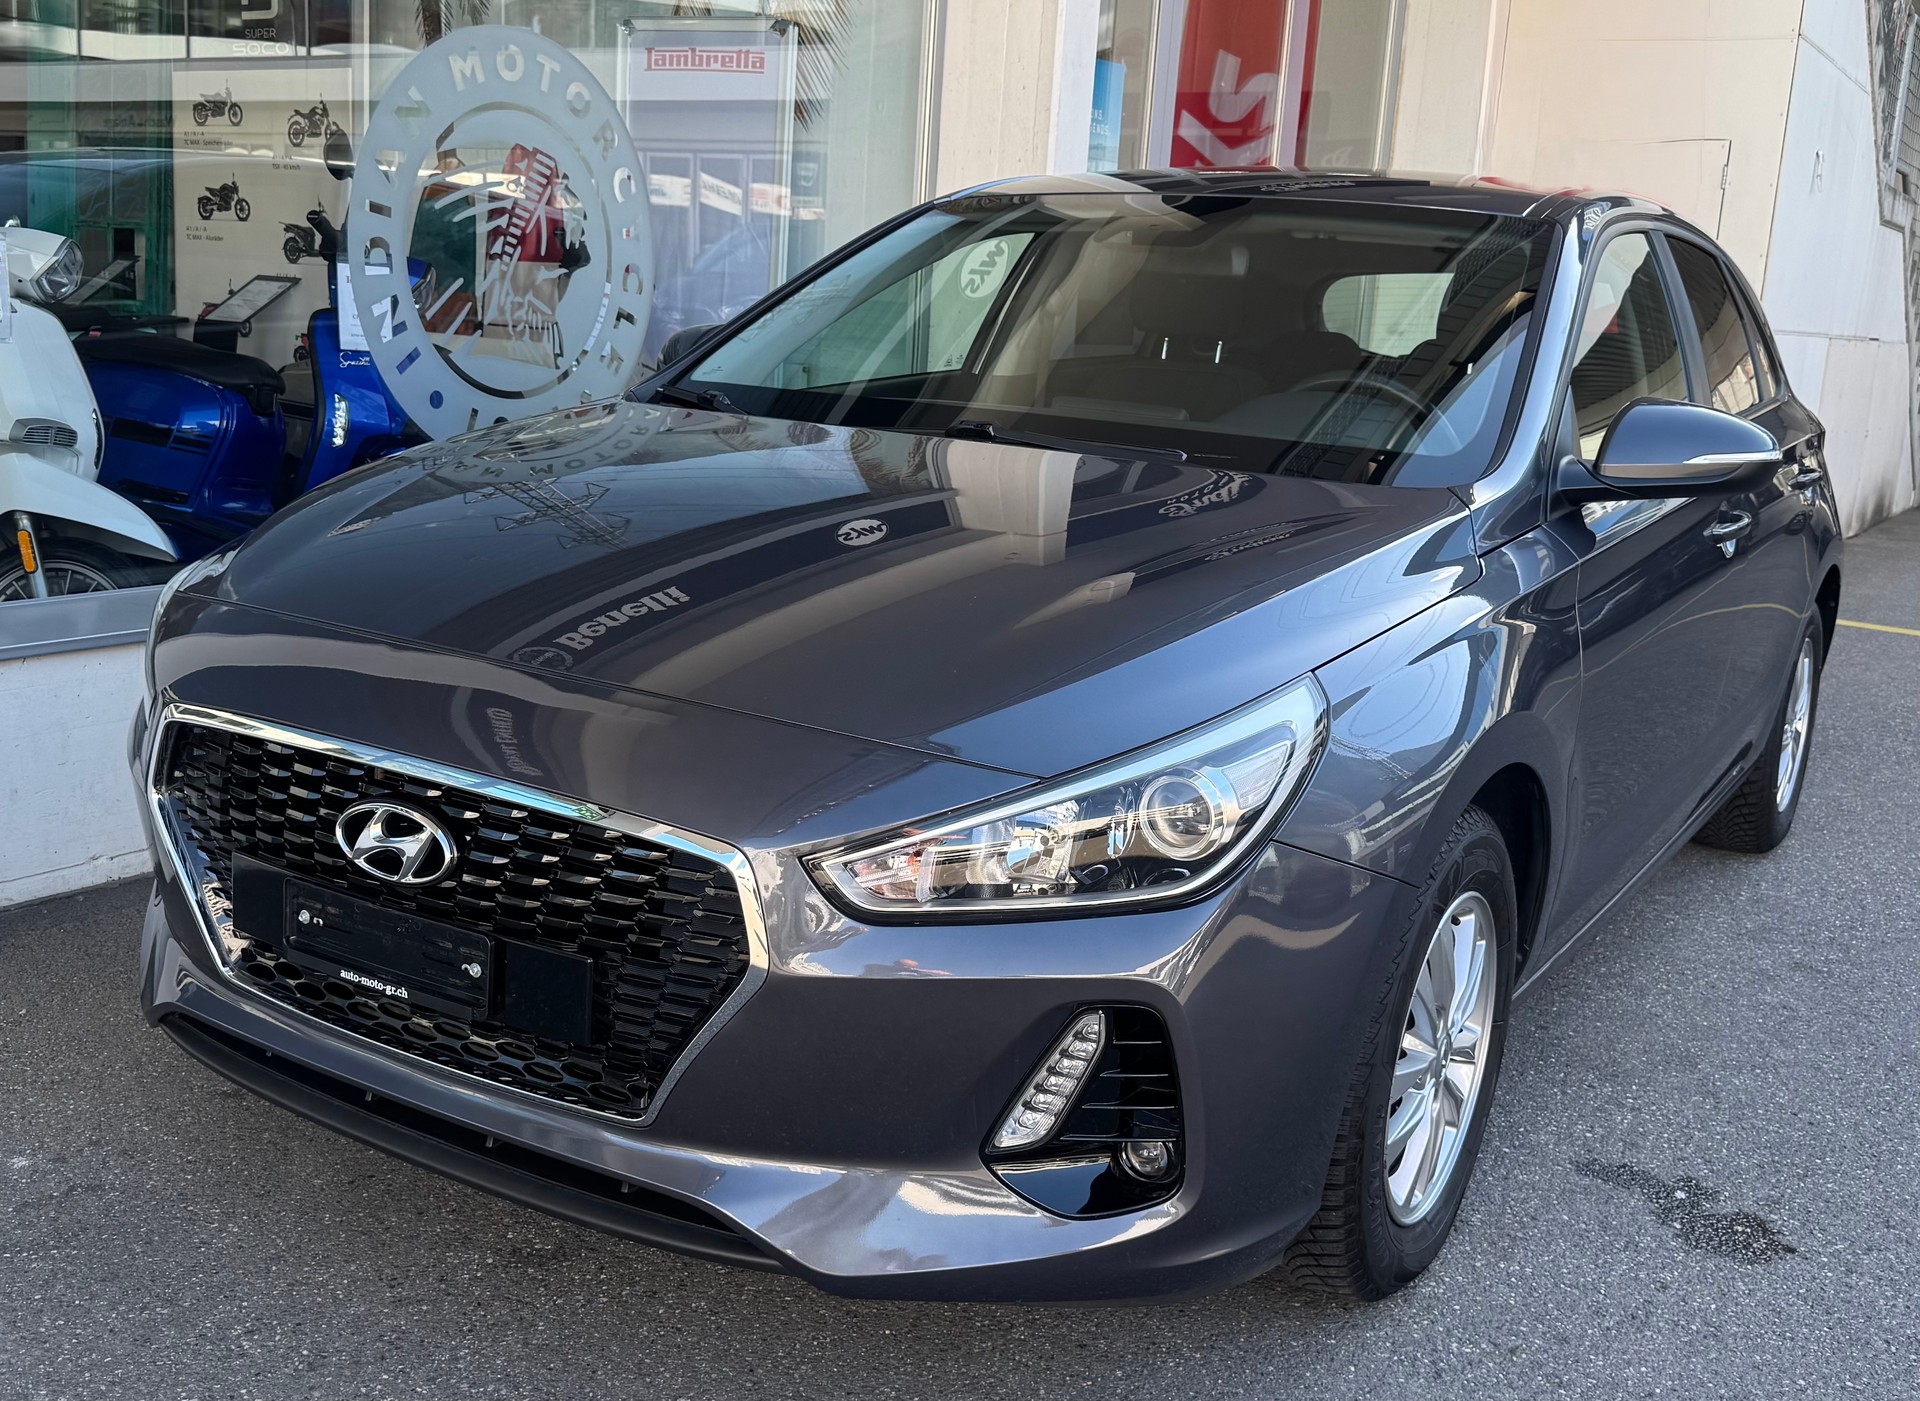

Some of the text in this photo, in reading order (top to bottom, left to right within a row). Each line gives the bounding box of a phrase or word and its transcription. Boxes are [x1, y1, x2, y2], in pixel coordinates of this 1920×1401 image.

[244, 27, 277, 39] SUPER
[232, 42, 289, 56] SOCO
[645, 47, 765, 74] Lambretta
[364, 44, 646, 378] INDIAN MOTORCYCLE
[340, 969, 408, 998] auto-moto-gr.ch
